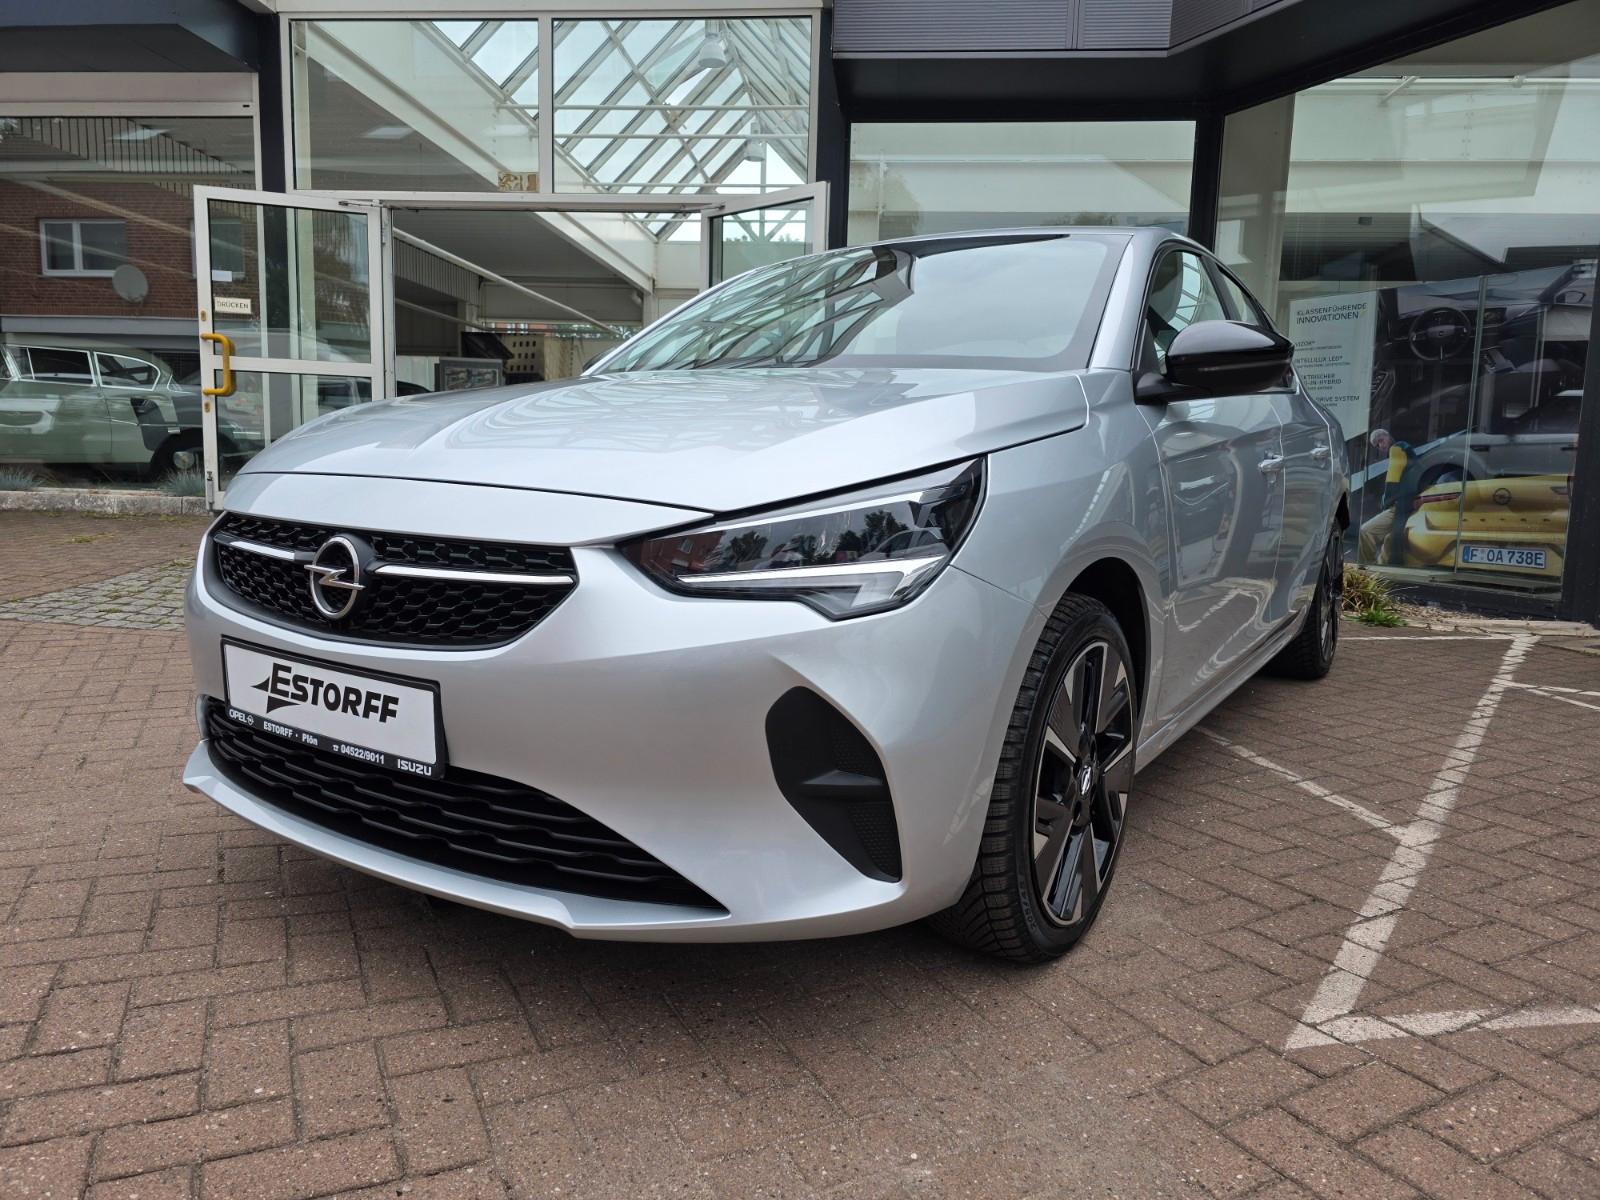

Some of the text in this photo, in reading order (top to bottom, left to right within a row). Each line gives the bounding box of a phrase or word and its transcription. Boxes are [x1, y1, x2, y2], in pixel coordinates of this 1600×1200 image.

[217, 300, 249, 309] DRÜCKEN
[1297, 303, 1367, 316] KLASSENFÜHRENDE
[1296, 311, 1359, 324] INNOVATIONEN
[1470, 548, 1479, 560] F
[1507, 551, 1544, 567] 738E
[270, 662, 399, 723] ESTORFF
[229, 707, 432, 777] OPEL ESTORFF Plön 04522/9011 ISUZU
